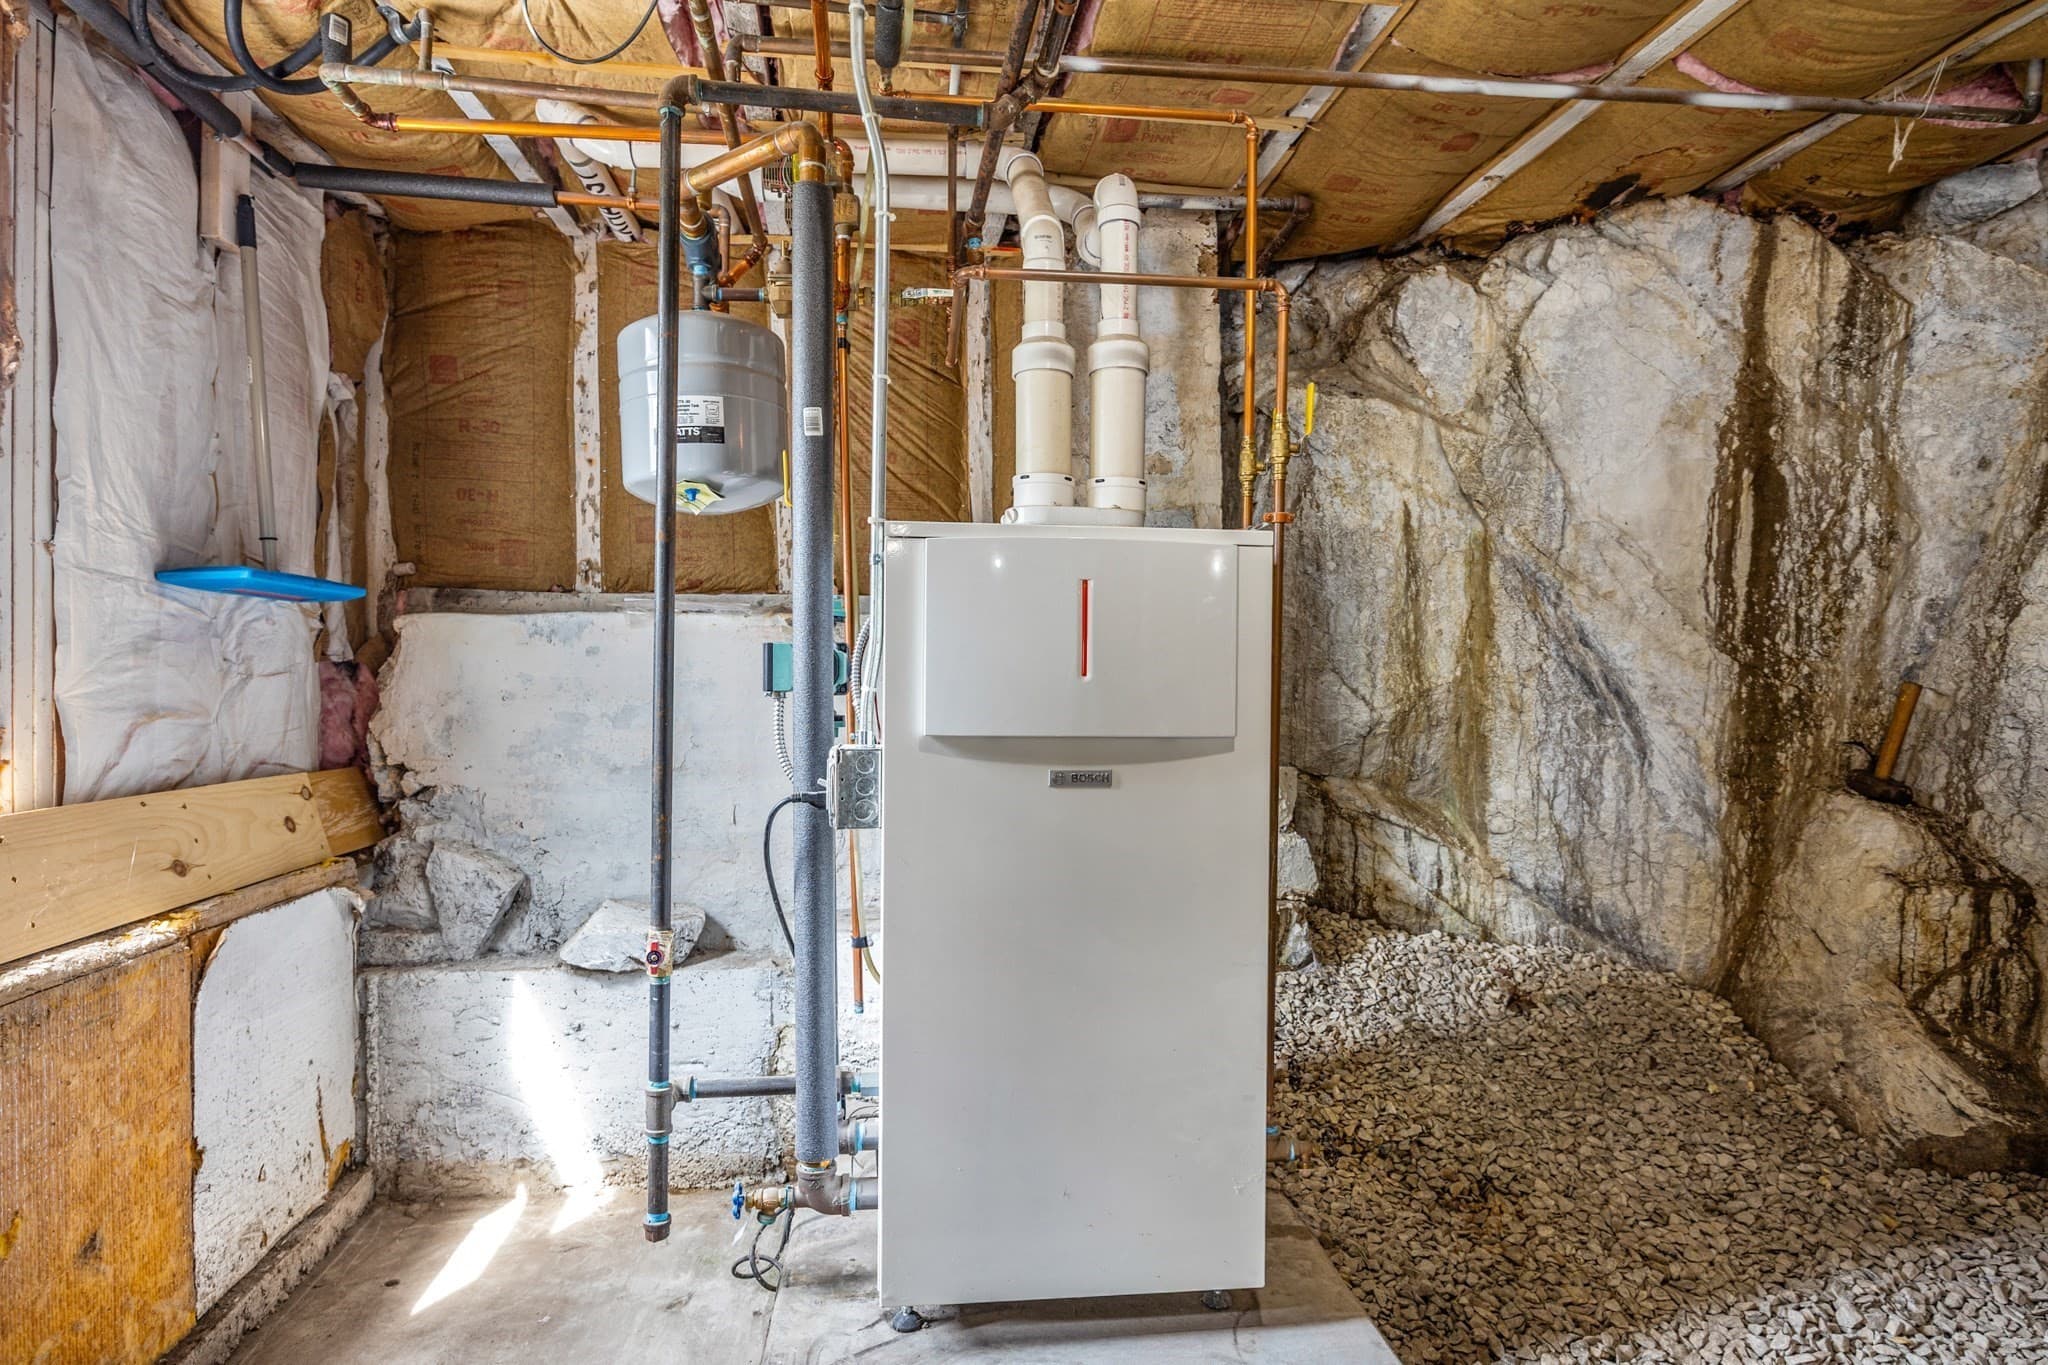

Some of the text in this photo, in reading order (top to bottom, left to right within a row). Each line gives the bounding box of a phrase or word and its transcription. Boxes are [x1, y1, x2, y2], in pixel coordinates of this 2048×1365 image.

[458, 419, 501, 434] R-30
[677, 427, 701, 436] ATTS
[455, 488, 500, 501] R-30
[1071, 772, 1110, 784] BOSCH
